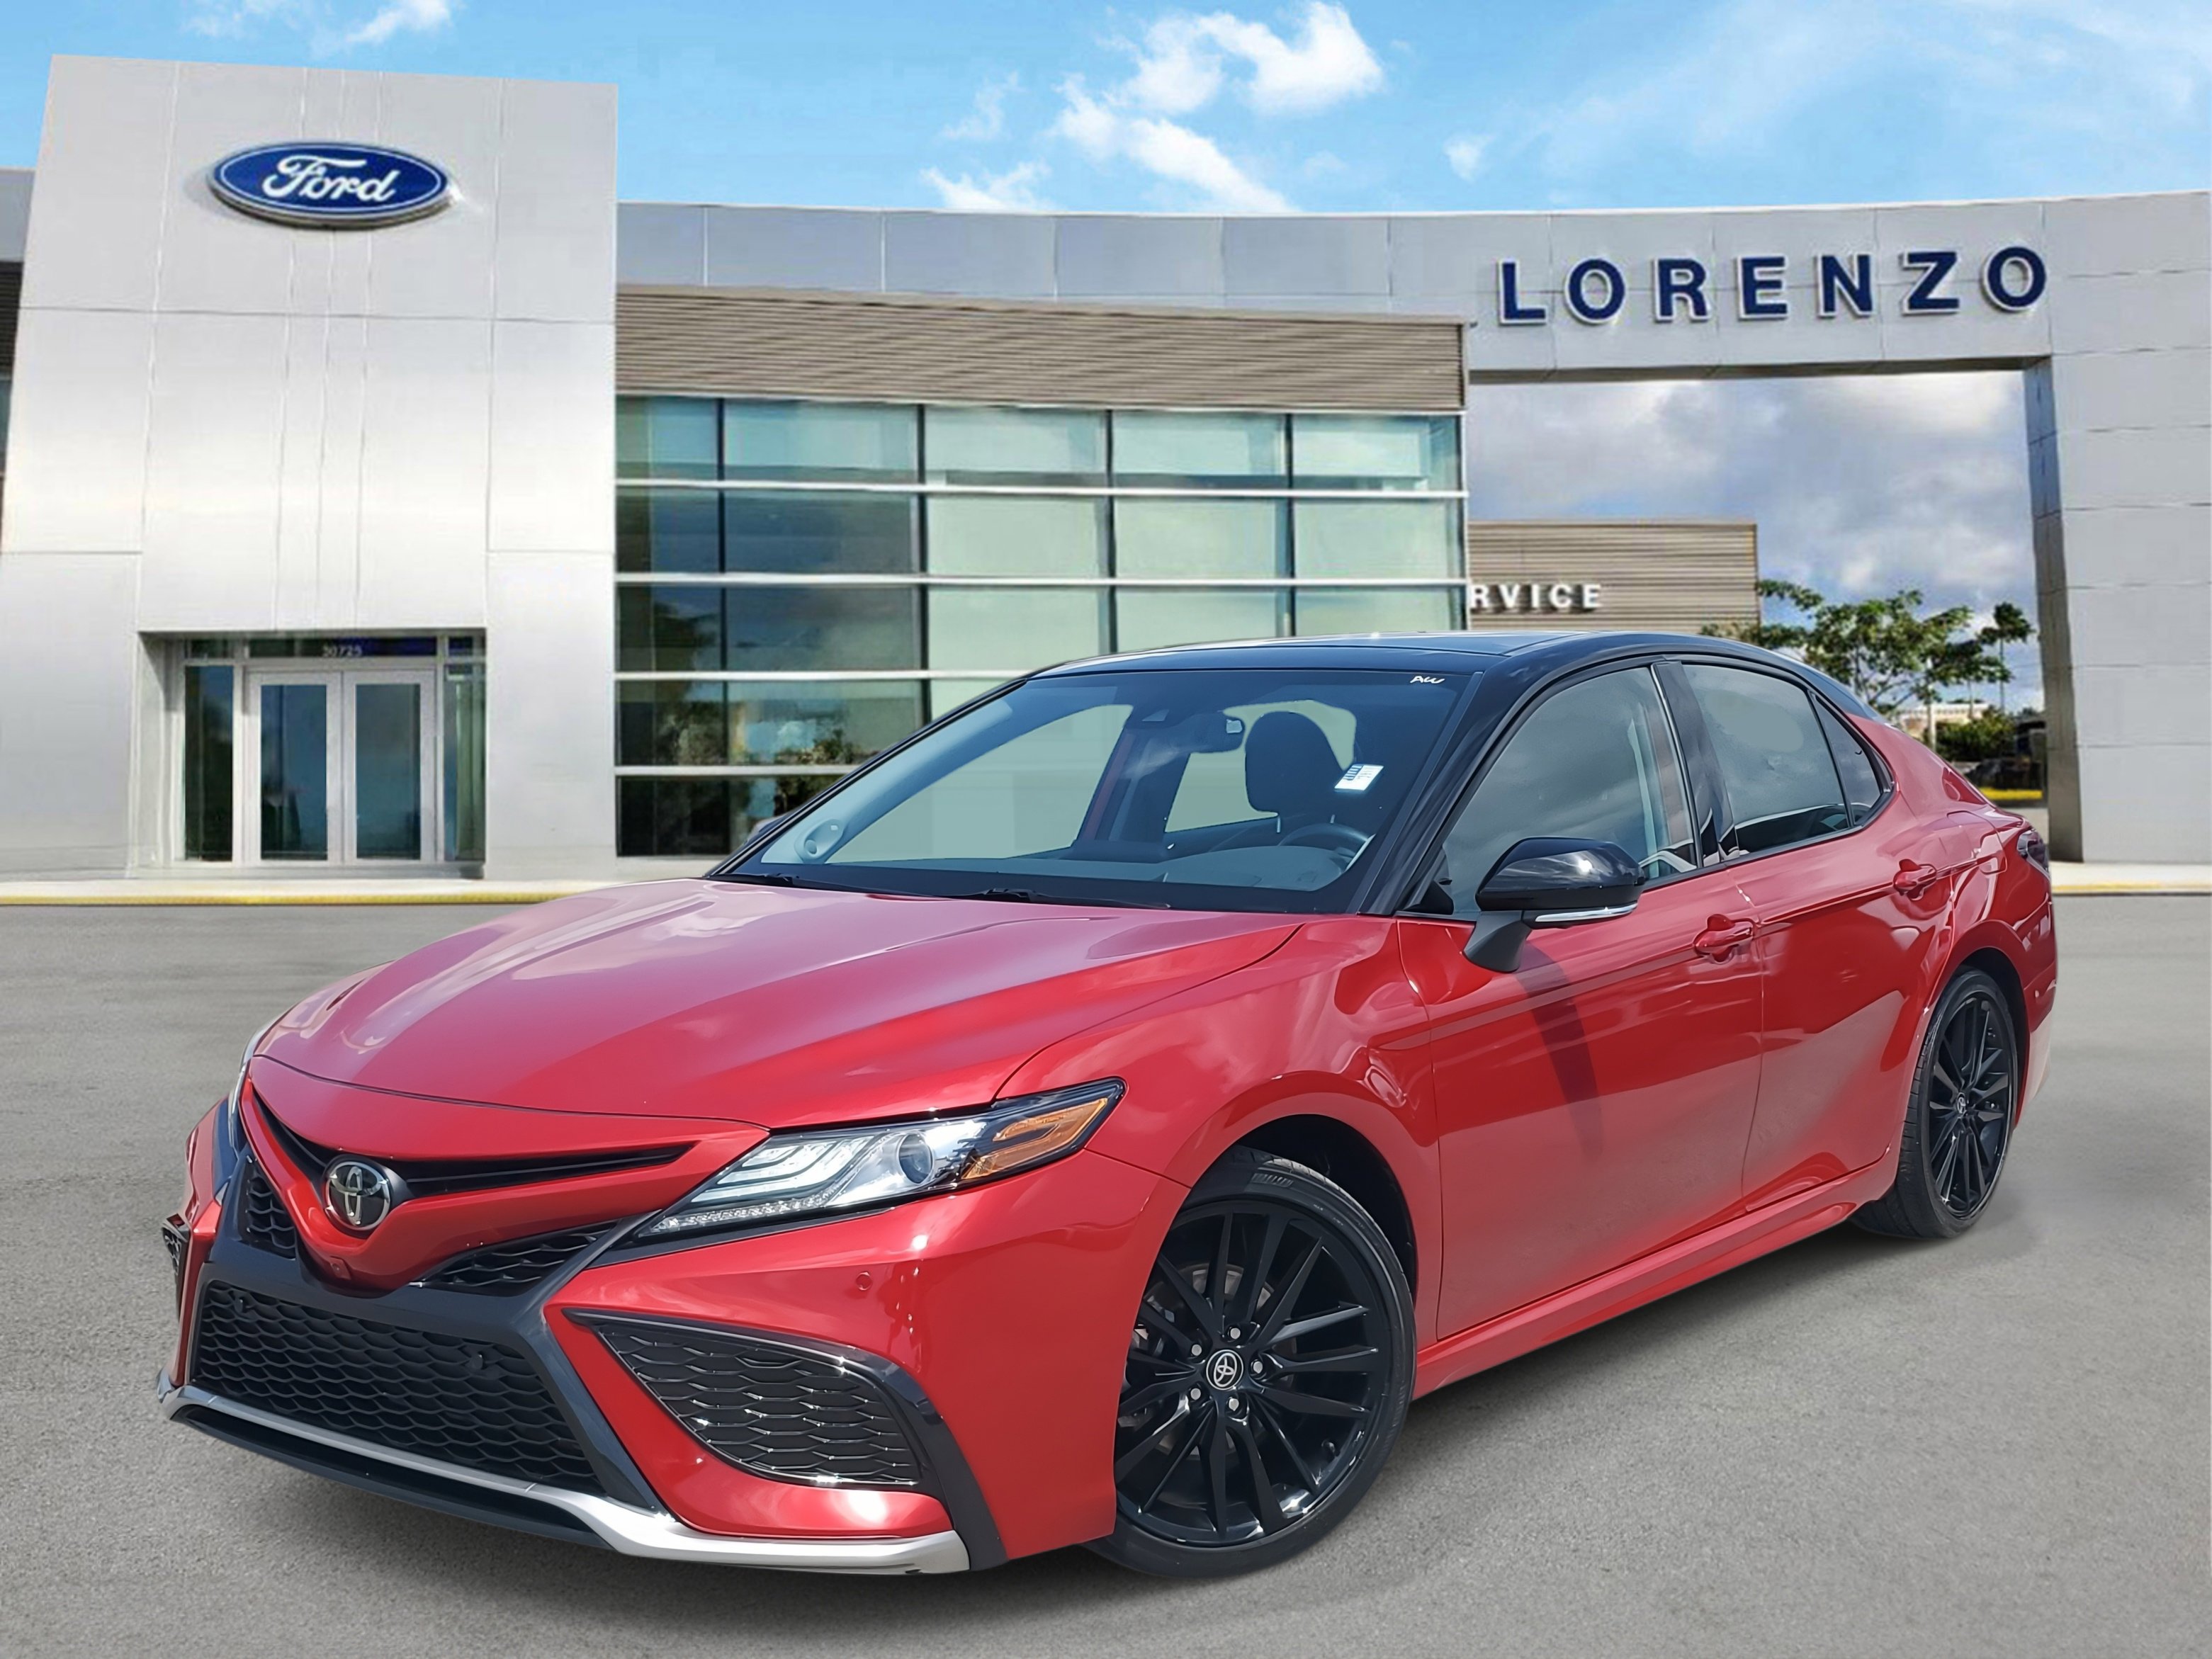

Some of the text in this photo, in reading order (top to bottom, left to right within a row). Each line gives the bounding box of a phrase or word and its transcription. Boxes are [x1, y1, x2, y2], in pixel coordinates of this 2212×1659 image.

[261, 154, 401, 202] Ford
[1497, 246, 2047, 325] LORENZO
[1470, 584, 1602, 608] RVICE
